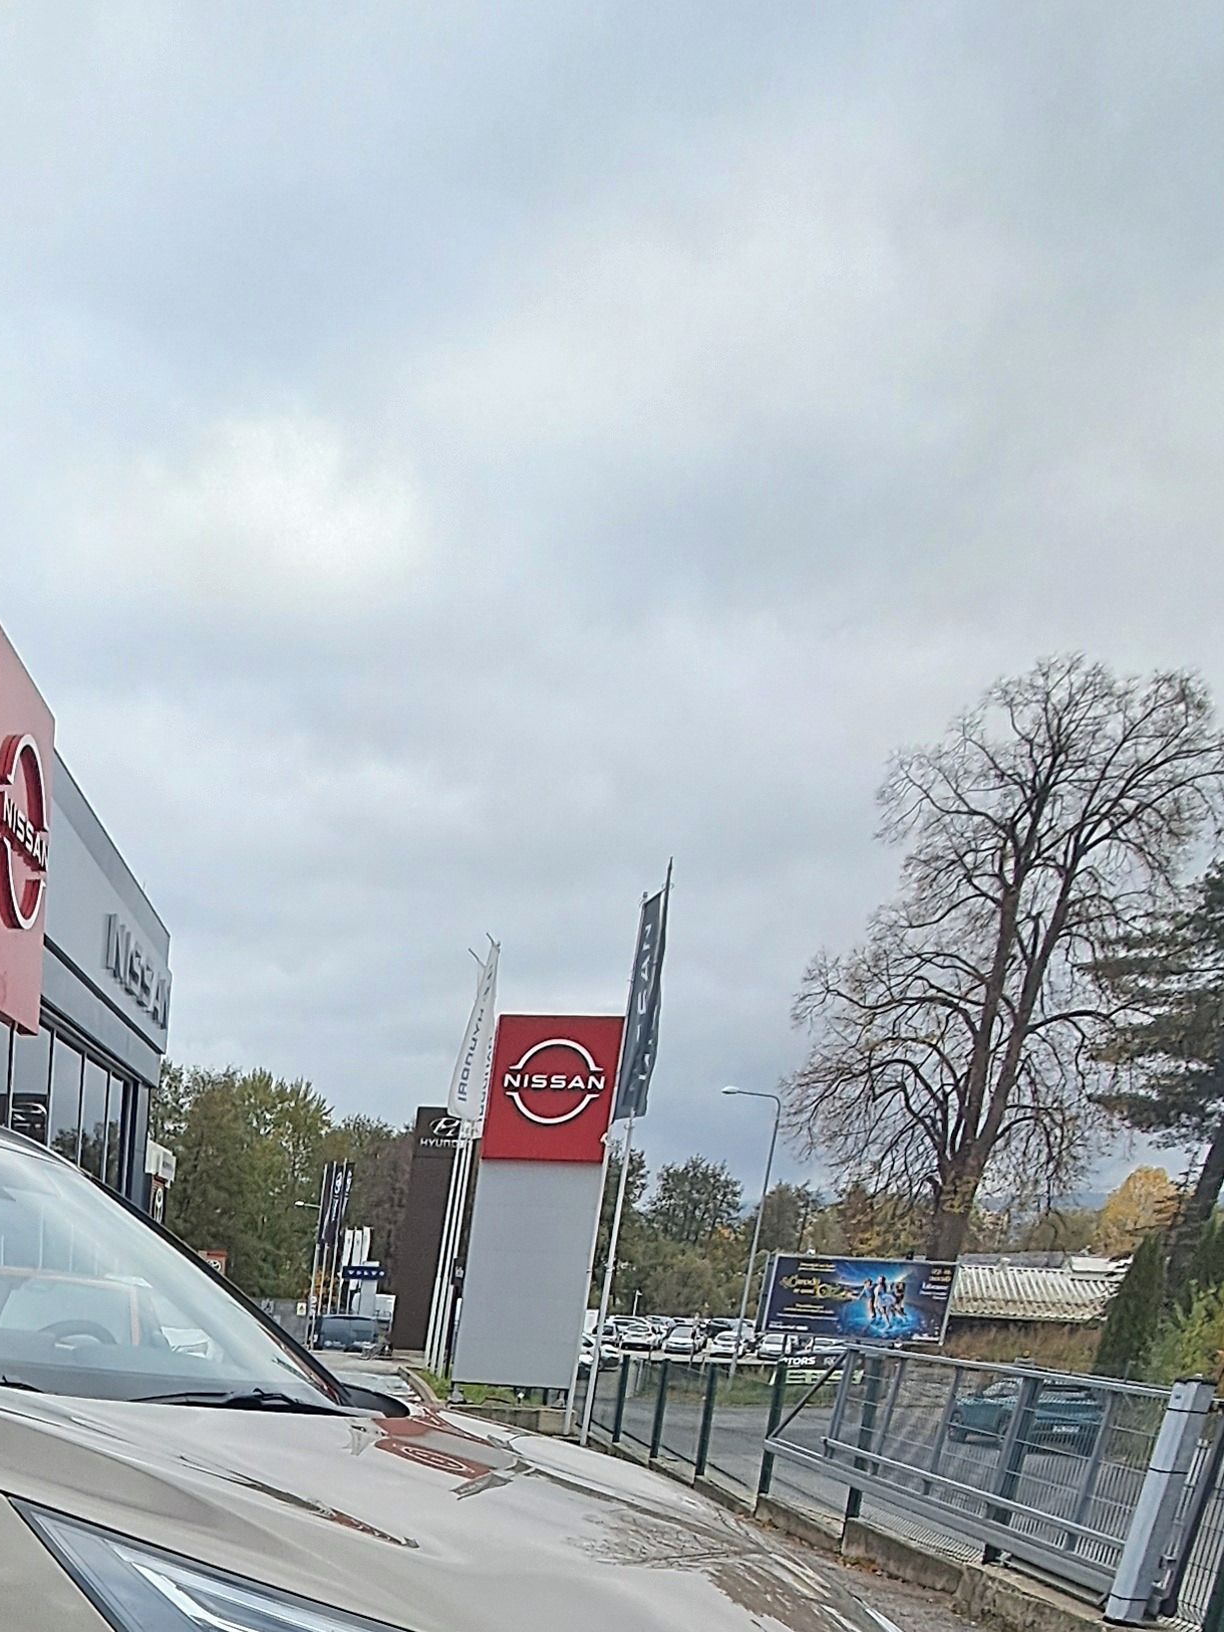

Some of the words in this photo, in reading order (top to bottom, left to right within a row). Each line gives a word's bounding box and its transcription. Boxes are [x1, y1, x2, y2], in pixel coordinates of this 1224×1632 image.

[2, 789, 49, 873] NISSAN
[105, 913, 172, 1030] NISSAN
[503, 1073, 606, 1091] NISSAN
[419, 1138, 460, 1148] HYUND
